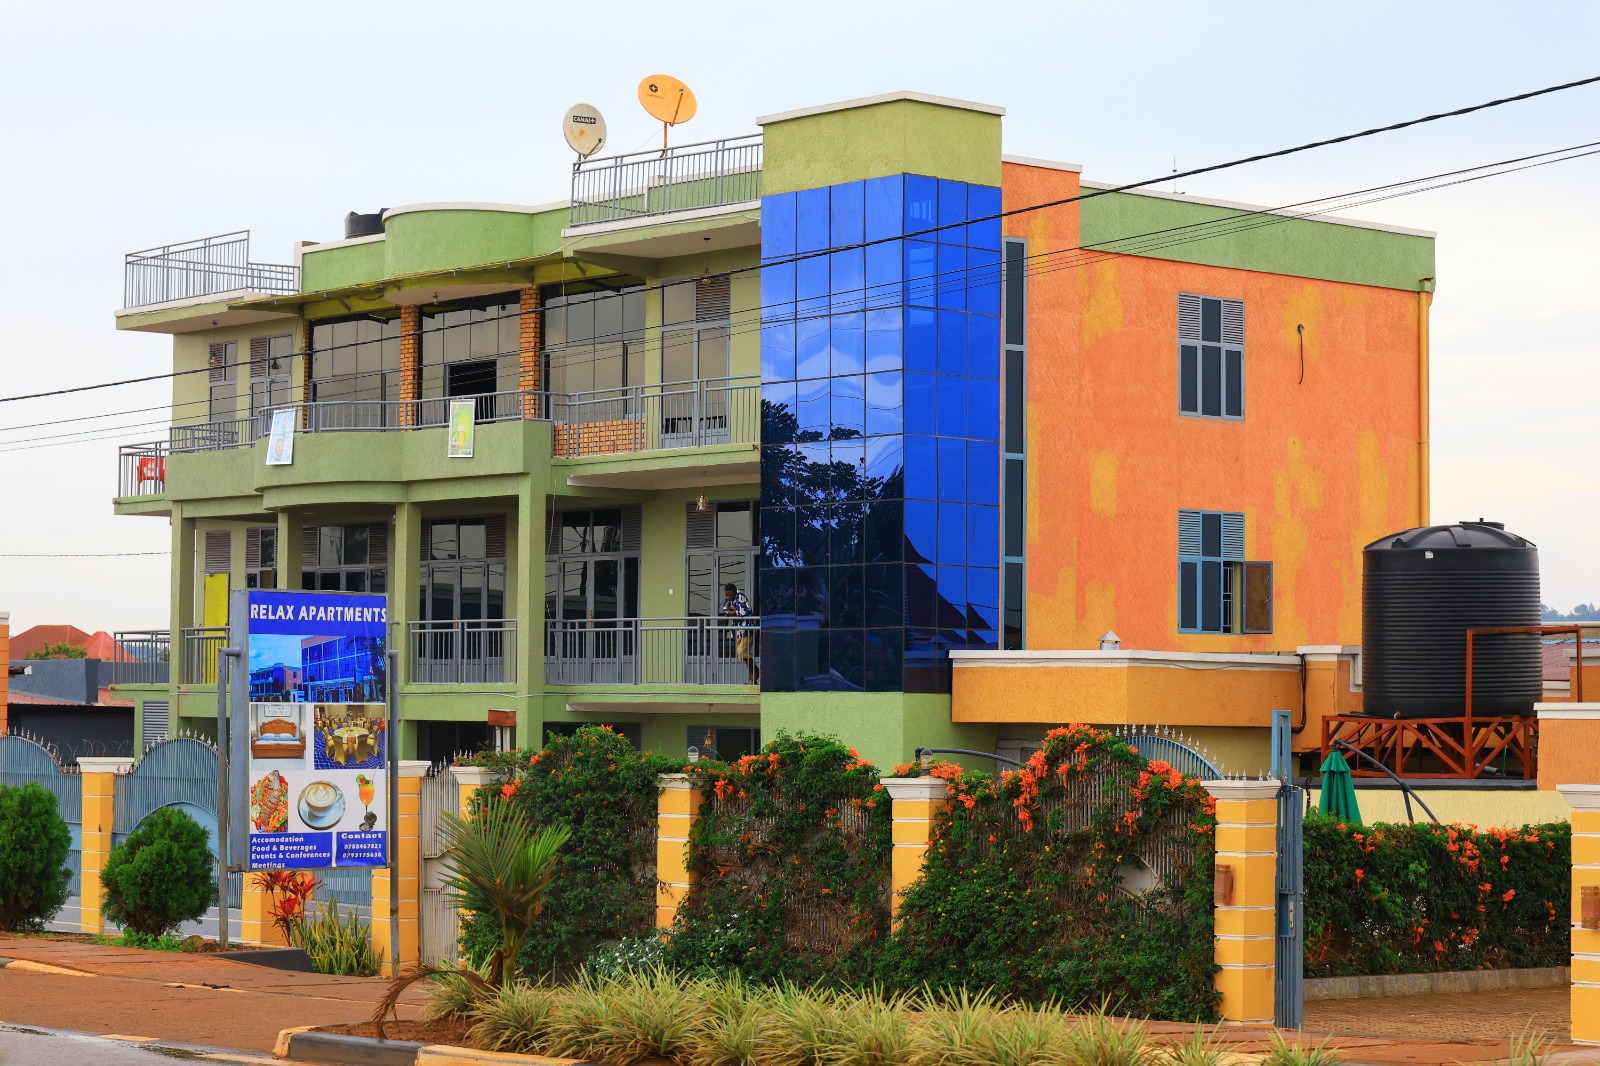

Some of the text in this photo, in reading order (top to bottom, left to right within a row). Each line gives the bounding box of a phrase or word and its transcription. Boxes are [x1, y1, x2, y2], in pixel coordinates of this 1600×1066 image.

[573, 116, 595, 124] CANAL+
[250, 604, 386, 622] RELAX APARTMENTS
